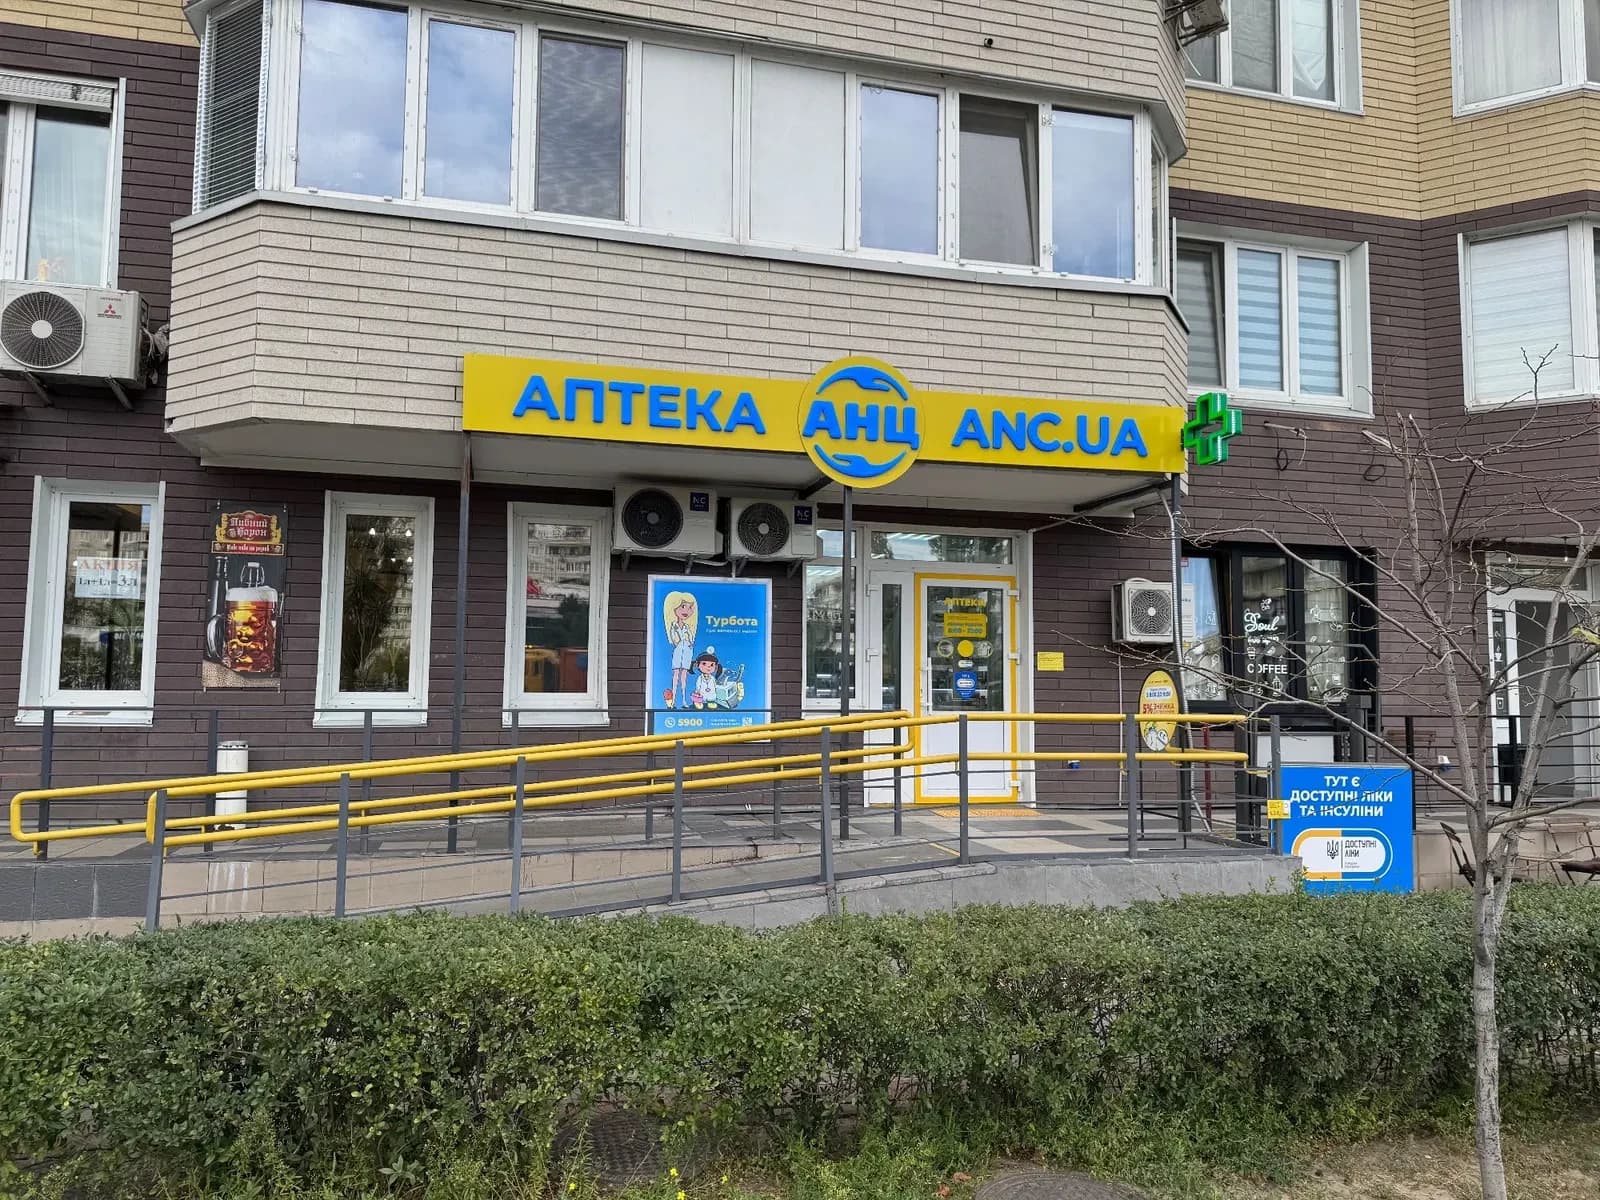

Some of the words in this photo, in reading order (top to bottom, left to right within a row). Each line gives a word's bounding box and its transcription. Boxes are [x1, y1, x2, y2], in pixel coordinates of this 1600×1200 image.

[512, 375, 767, 435] АПТЕКА
[802, 400, 920, 450] АНЦ
[952, 408, 1148, 457] ANC.UA
[79, 559, 138, 571] АКЦІЯ
[705, 615, 758, 627] Турбота
[1244, 611, 1280, 632] Soul
[677, 718, 703, 727] 5900
[1324, 775, 1348, 787] ТУТ
[1351, 776, 1361, 787] Є
[1290, 790, 1358, 802] ДОСТУПНІ
[1300, 805, 1317, 816] ТА
[1320, 805, 1384, 816] ІНСУЛІНИ
[1344, 840, 1377, 849] ДОСТУПНІ
[1344, 849, 1360, 858] ЛІКИ
